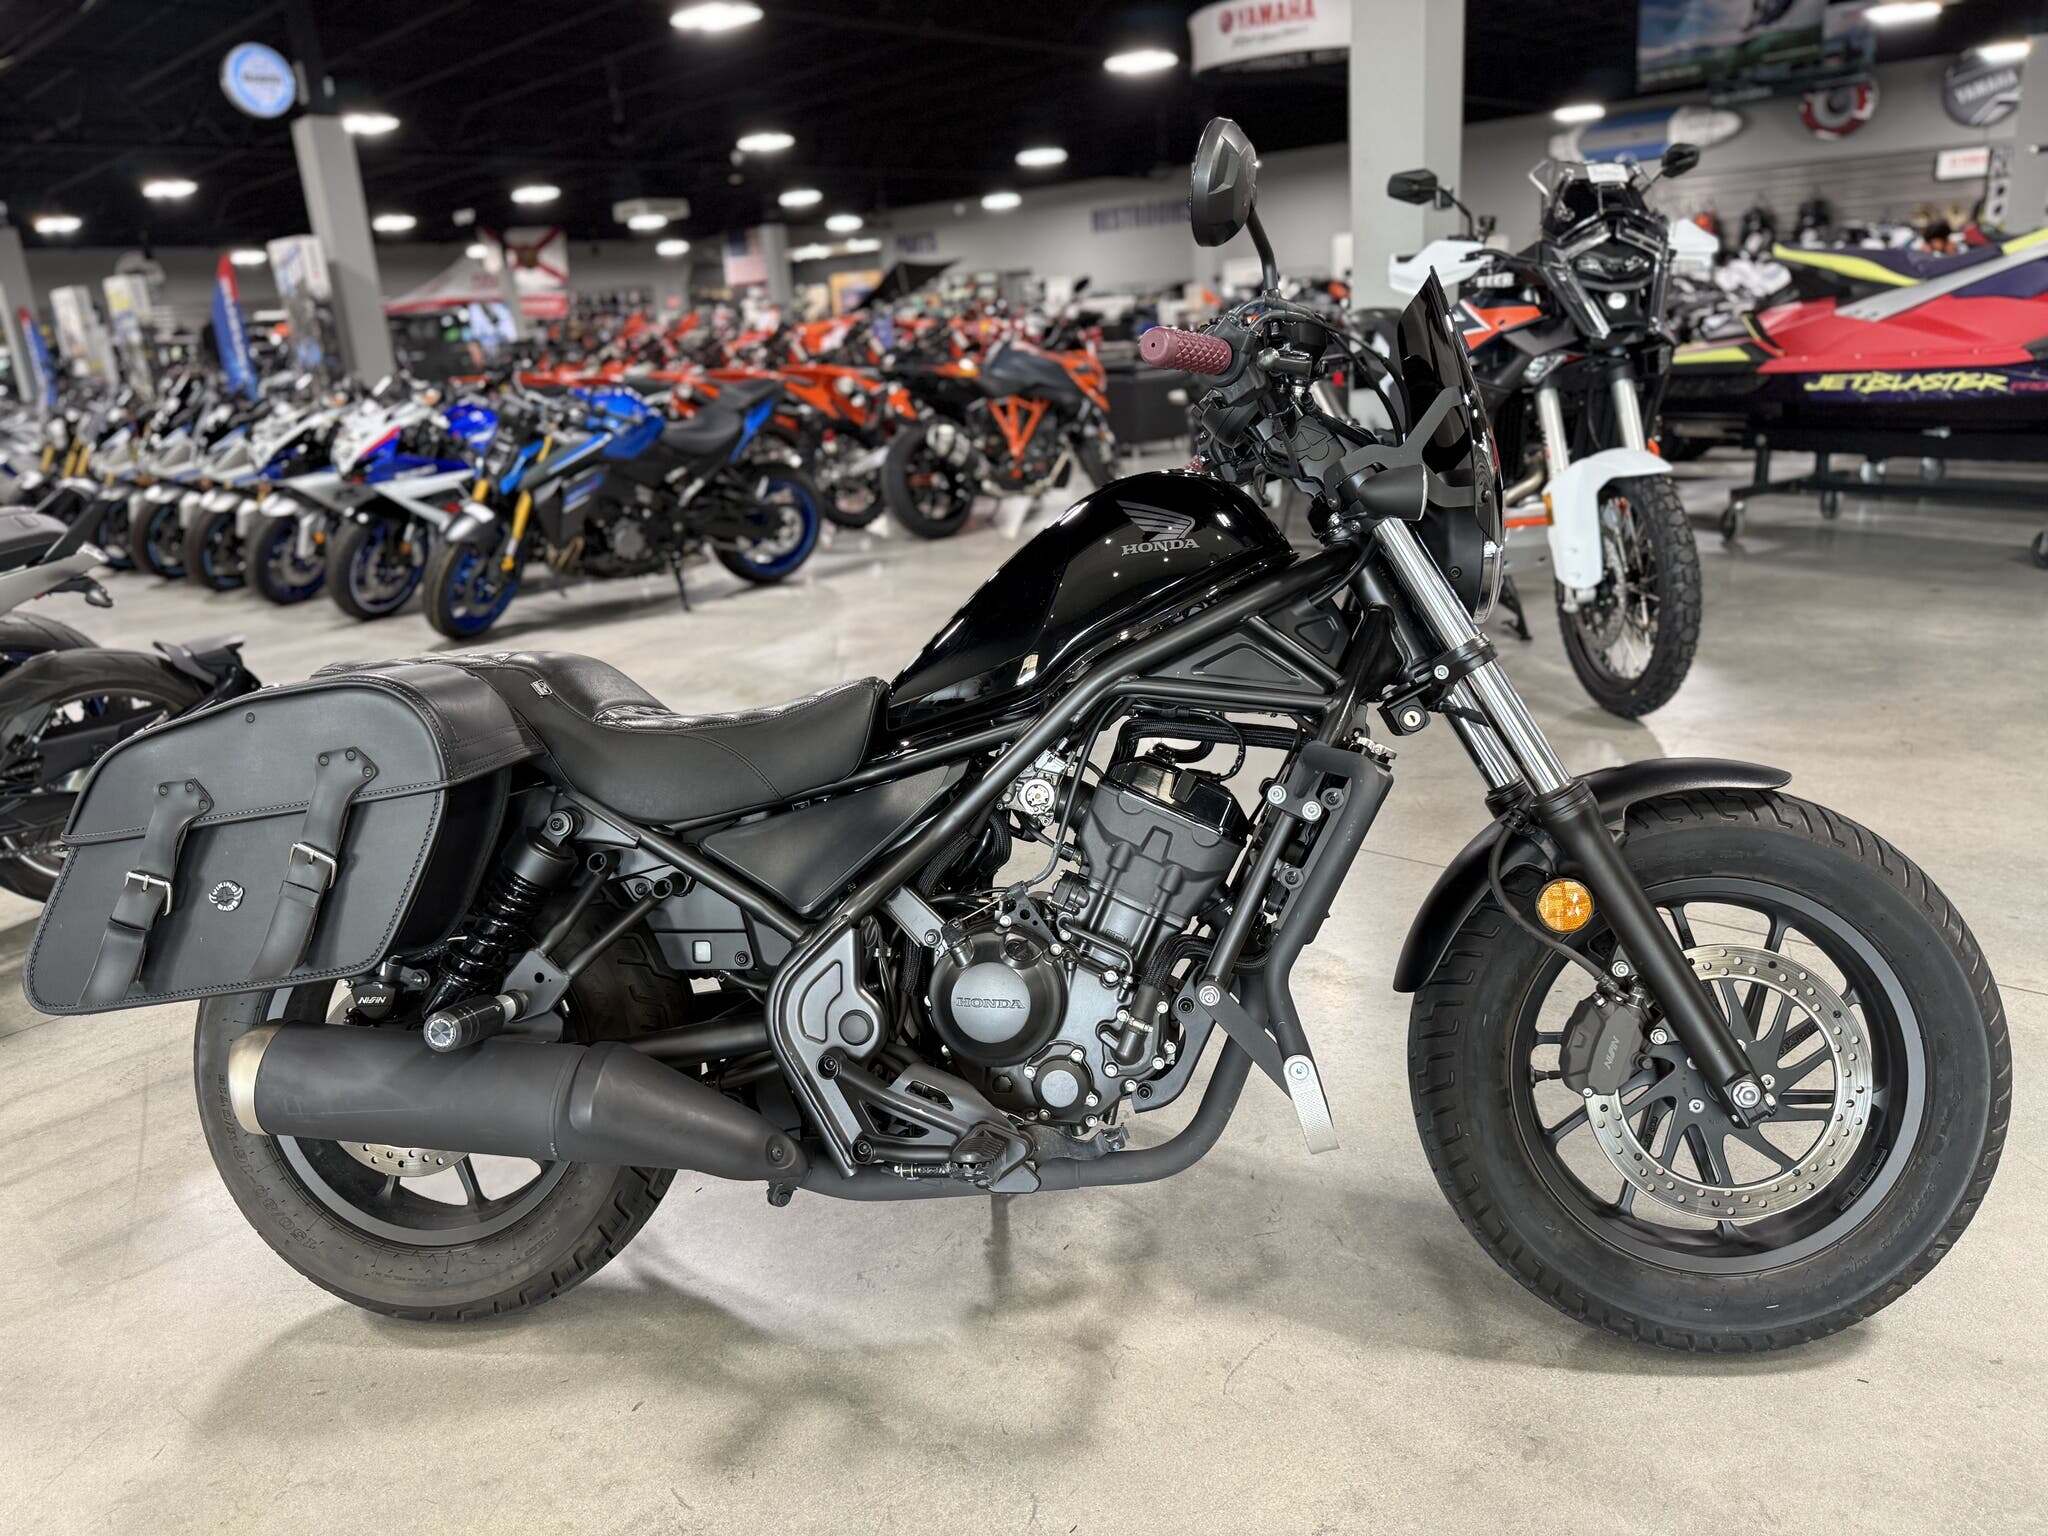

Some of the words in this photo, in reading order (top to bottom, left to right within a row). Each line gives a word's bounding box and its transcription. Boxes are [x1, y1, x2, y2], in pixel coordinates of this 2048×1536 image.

[1804, 371, 2009, 394] JETBLASTER
[1120, 538, 1200, 557] HONDA
[212, 881, 238, 895] VIKING
[217, 900, 239, 912] BAGS
[955, 997, 1026, 1010] HONDA
